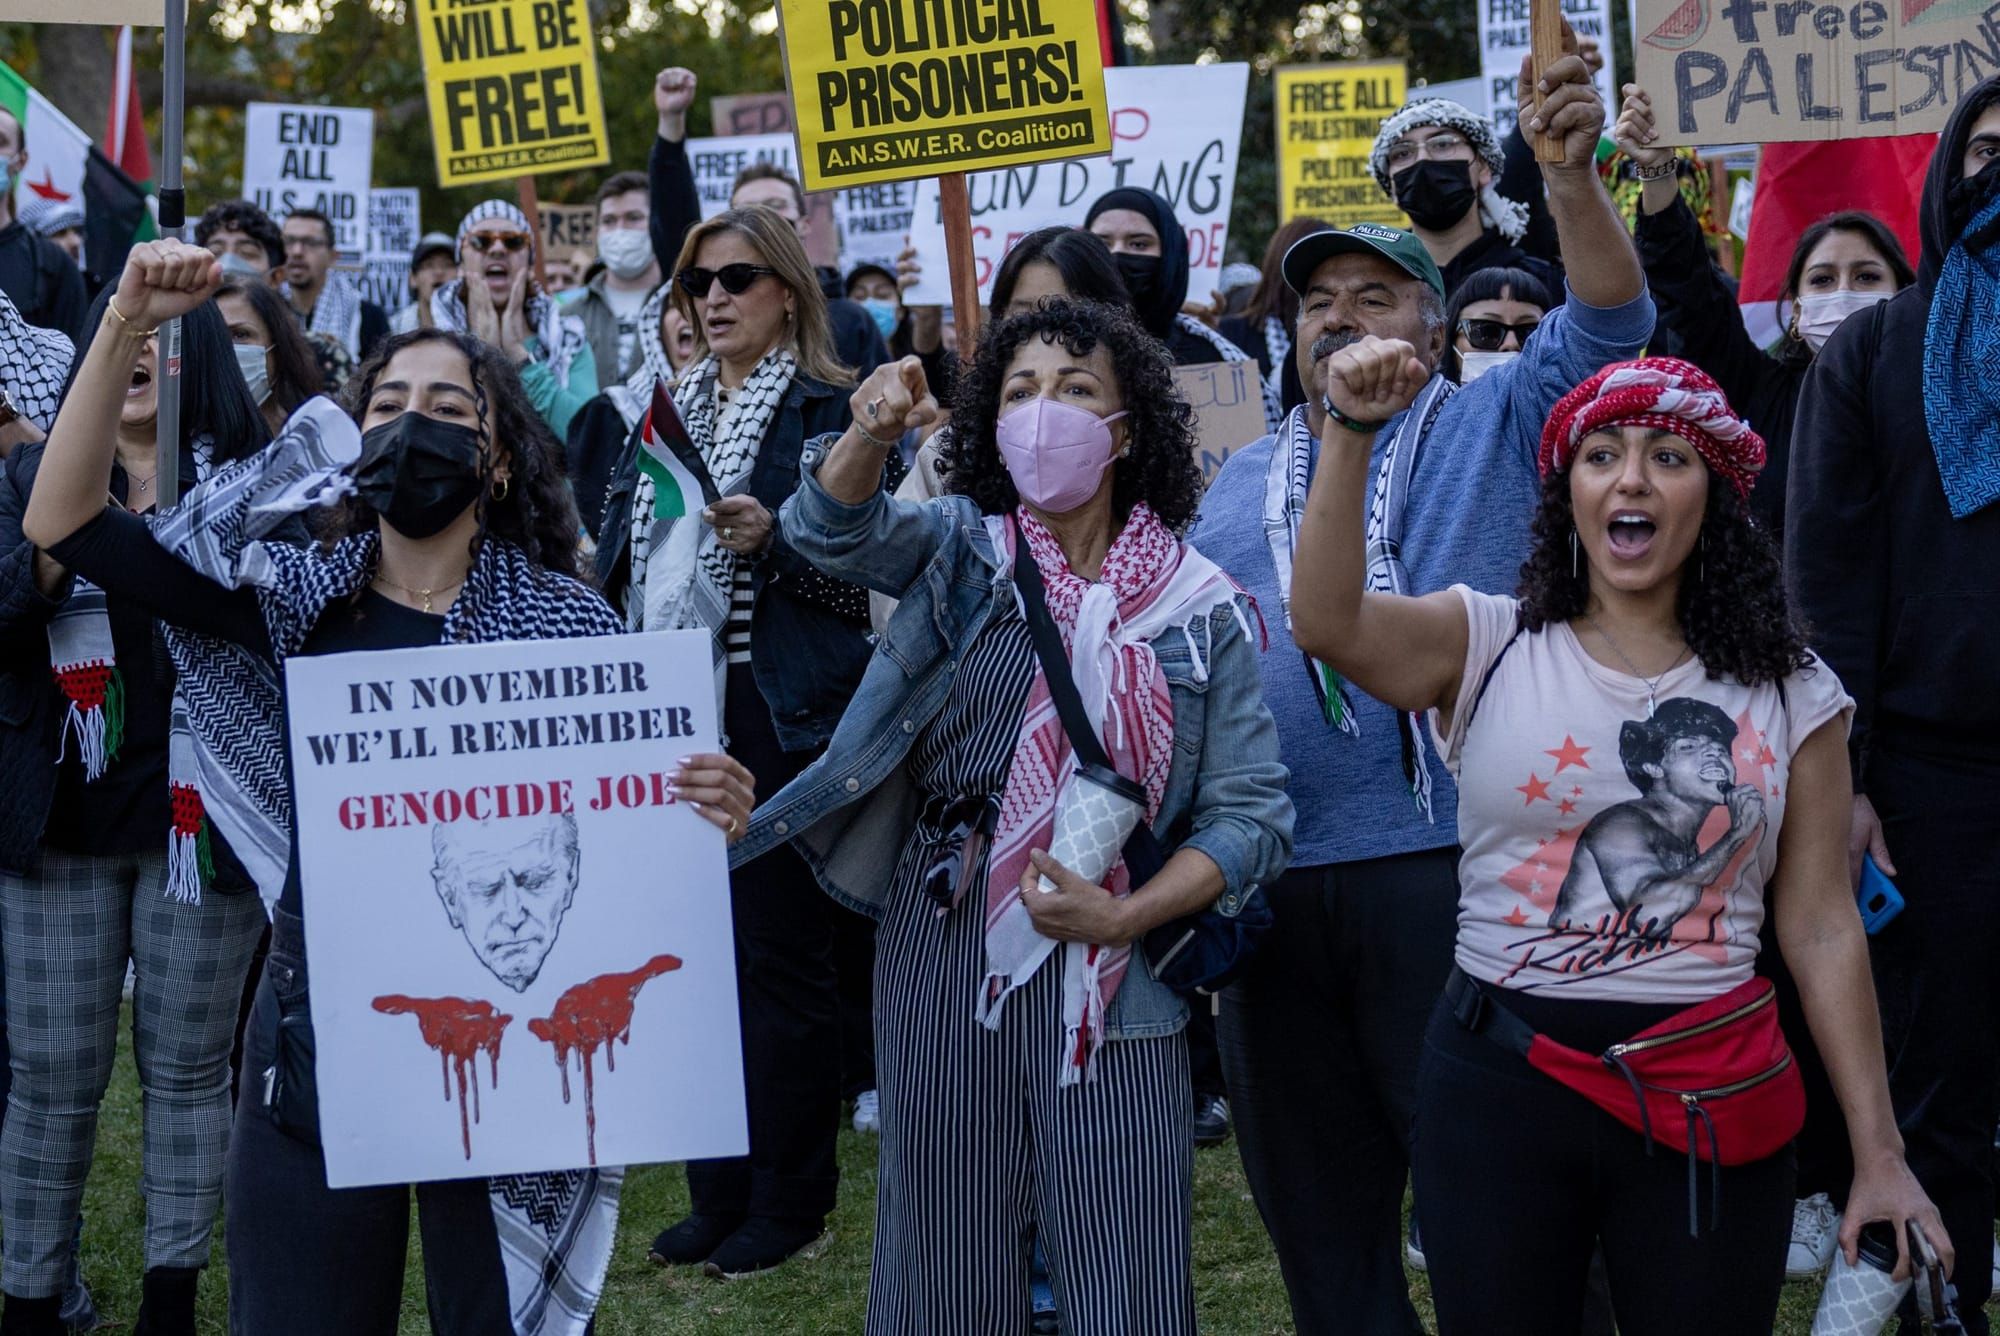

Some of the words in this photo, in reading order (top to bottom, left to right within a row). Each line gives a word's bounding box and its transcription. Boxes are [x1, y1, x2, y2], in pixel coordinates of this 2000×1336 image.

[433, 7, 526, 63] WILL
[532, 0, 581, 51] BE
[829, 0, 1055, 61] POLITICAL
[1488, 0, 1530, 23] FRE
[444, 64, 591, 151] FREE!
[817, 40, 1084, 132] PRISONERS!
[1290, 81, 1345, 112] FREE
[1355, 79, 1396, 109] ALL
[279, 112, 340, 146] END
[826, 133, 971, 169] A.N.S.W.E.R.
[977, 121, 1086, 150] Coalition
[281, 149, 334, 181] ALL
[933, 139, 1224, 224] UNDING
[314, 192, 355, 220] AID
[848, 181, 906, 211] FREE
[1356, 225, 1401, 240] PALESTINE
[347, 681, 394, 714] IN
[411, 661, 649, 710] NOVEMBER
[307, 726, 438, 766] WE'LL
[450, 706, 696, 755] REMEMBER
[338, 780, 575, 831] GENOCIDE
